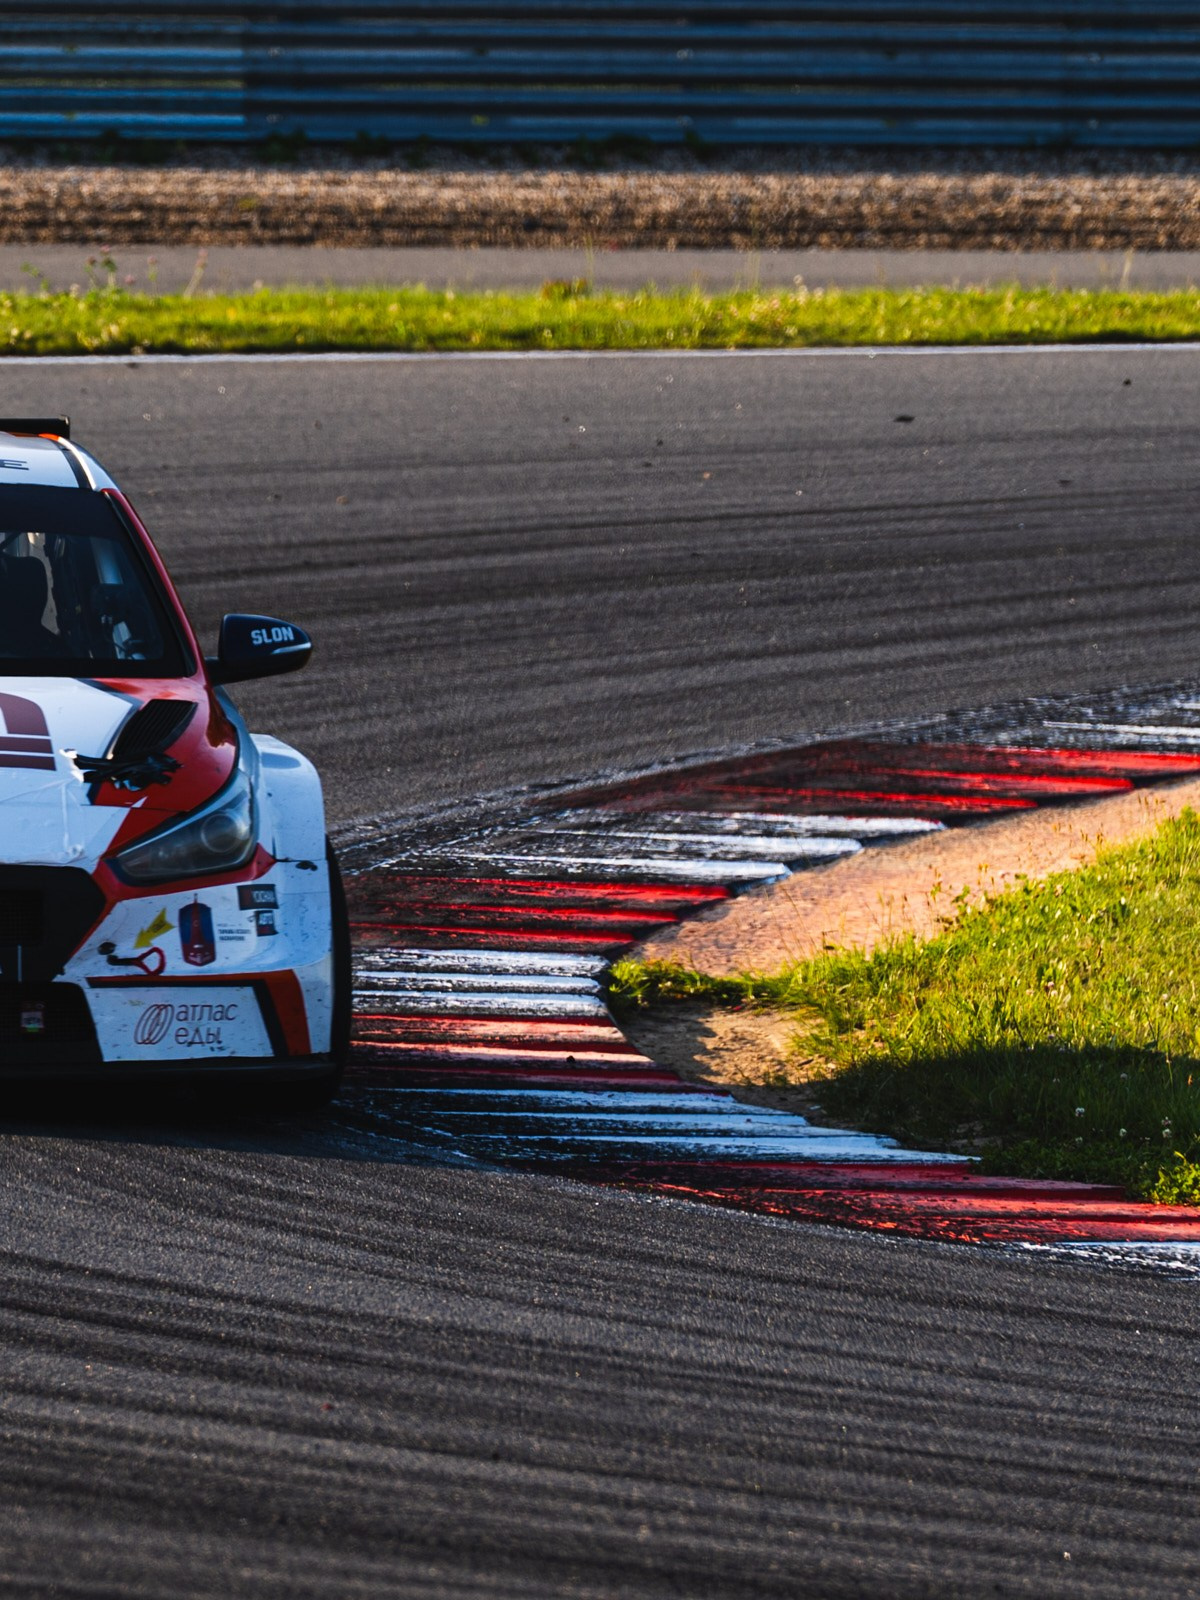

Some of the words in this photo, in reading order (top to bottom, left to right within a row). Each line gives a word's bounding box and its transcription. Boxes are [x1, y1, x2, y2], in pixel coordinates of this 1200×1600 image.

[250, 626, 295, 645] SLON
[175, 1003, 238, 1021] атлас
[174, 1026, 222, 1047] еды
